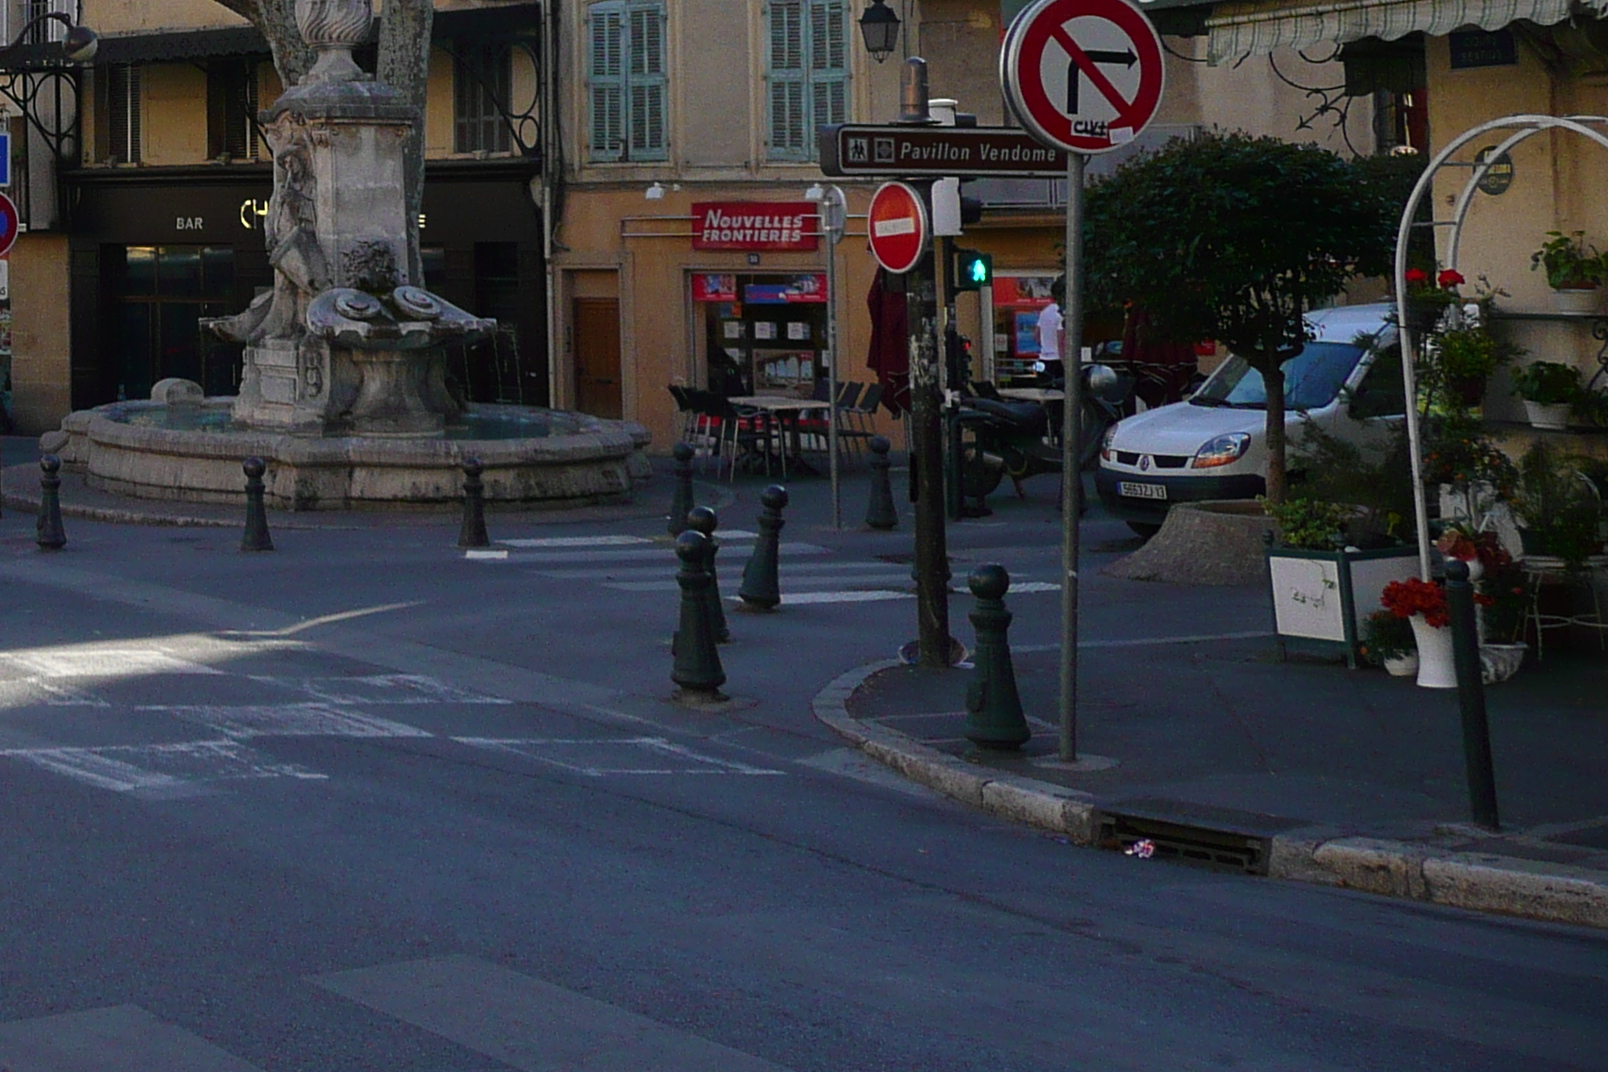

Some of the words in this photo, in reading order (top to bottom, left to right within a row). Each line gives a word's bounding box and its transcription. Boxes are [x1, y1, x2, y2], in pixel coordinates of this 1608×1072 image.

[900, 141, 970, 160] Pavillon
[176, 217, 203, 230] BAR
[705, 209, 803, 228] NOUVELLES
[702, 229, 801, 242] FRONTIERES
